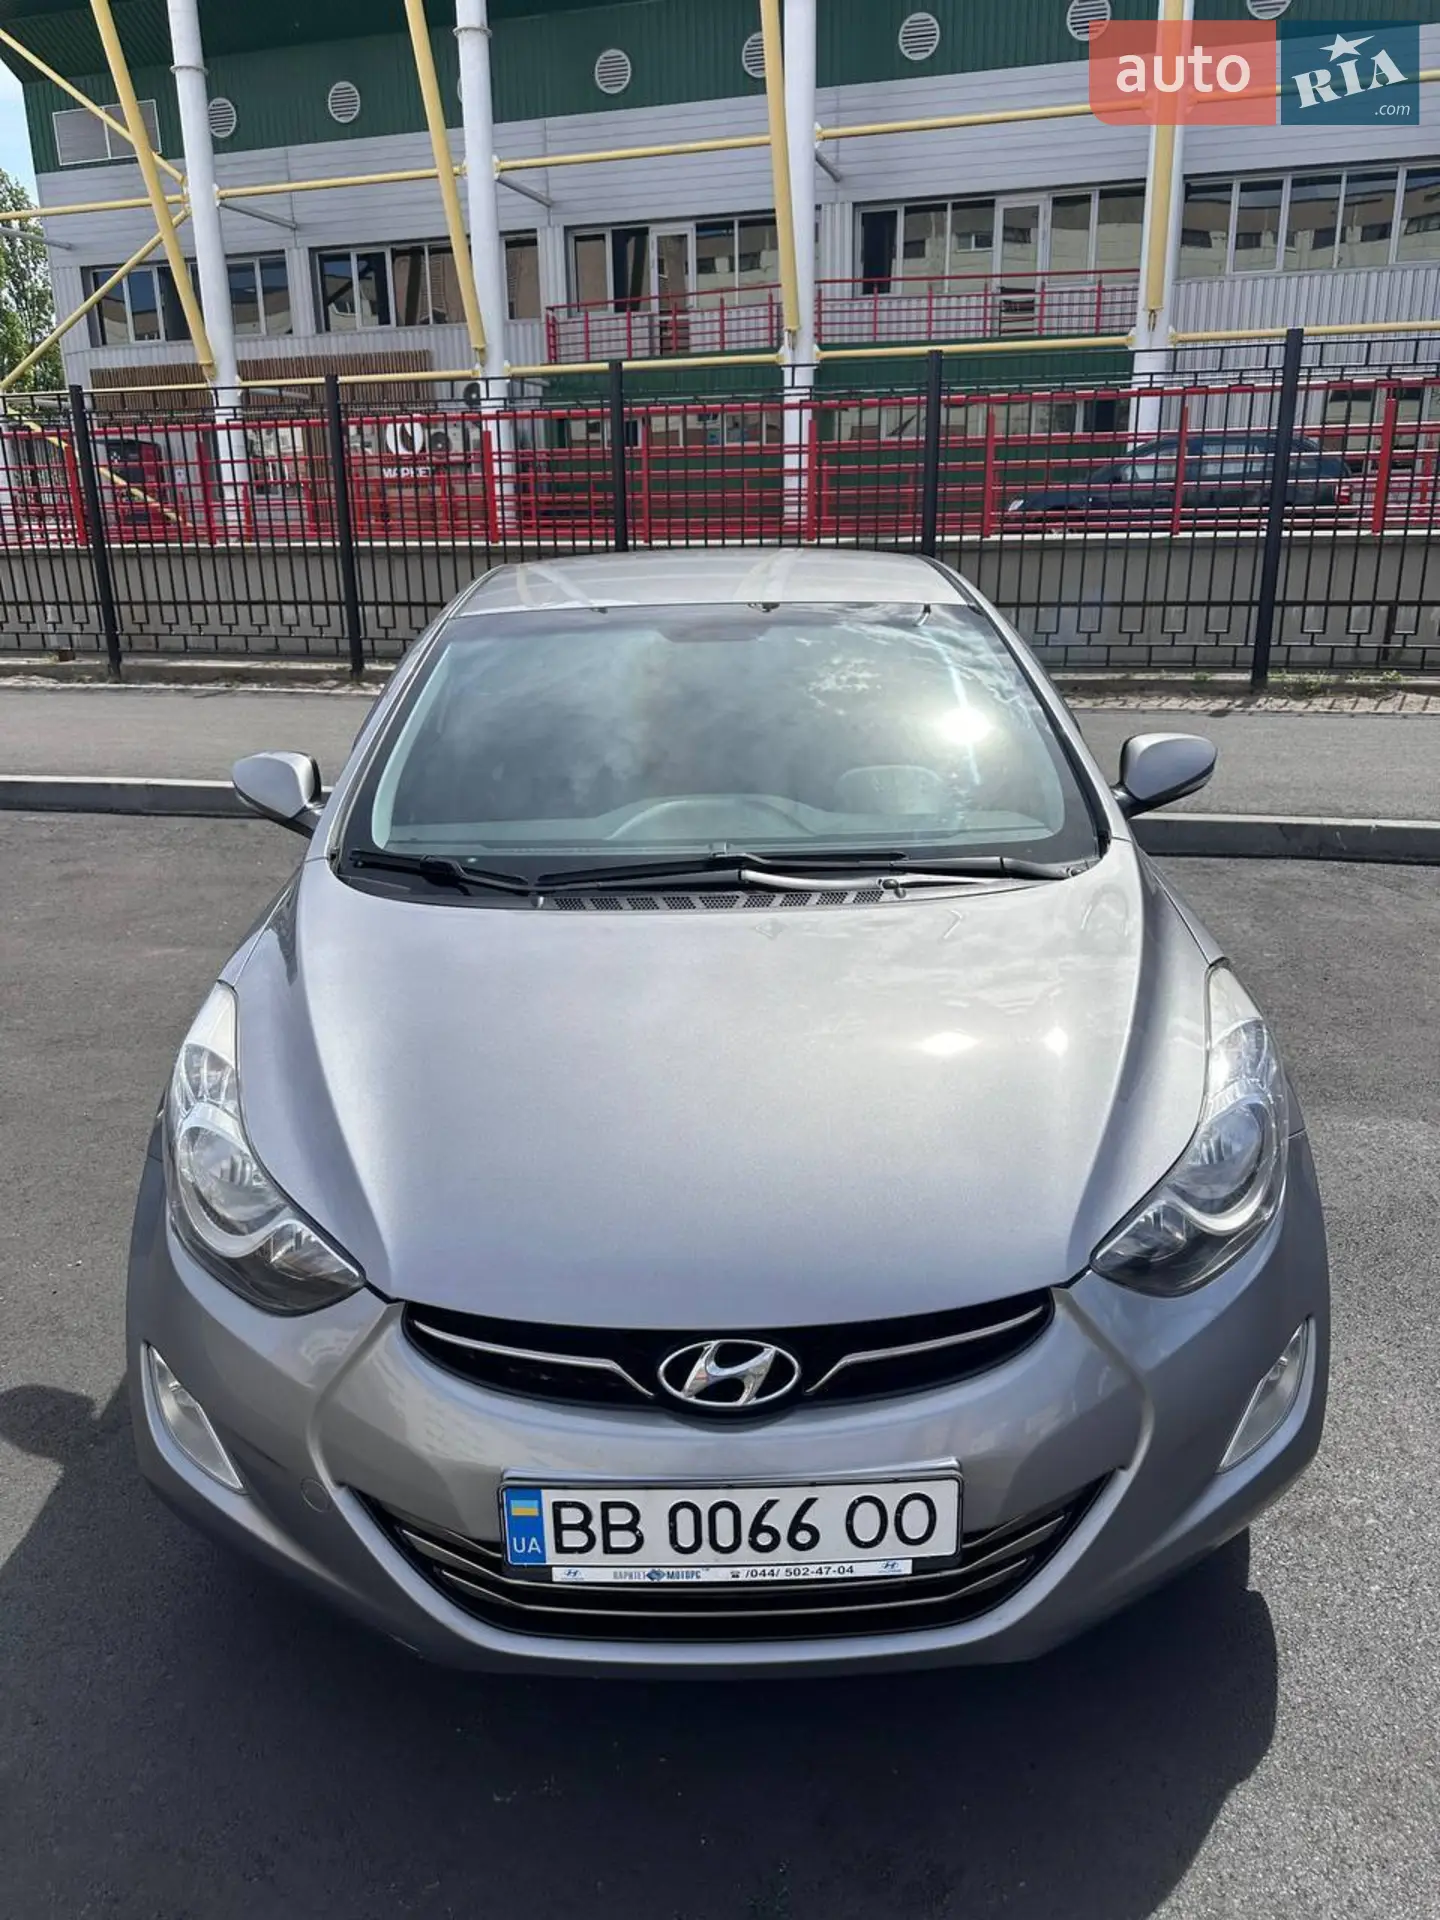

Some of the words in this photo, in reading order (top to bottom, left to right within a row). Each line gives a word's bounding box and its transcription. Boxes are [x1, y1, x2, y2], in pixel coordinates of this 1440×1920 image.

[551, 1500, 645, 1555] BB
[668, 1497, 821, 1555] 0066
[512, 1537, 542, 1555] UA
[785, 1565, 855, 1577] 502-47-04
